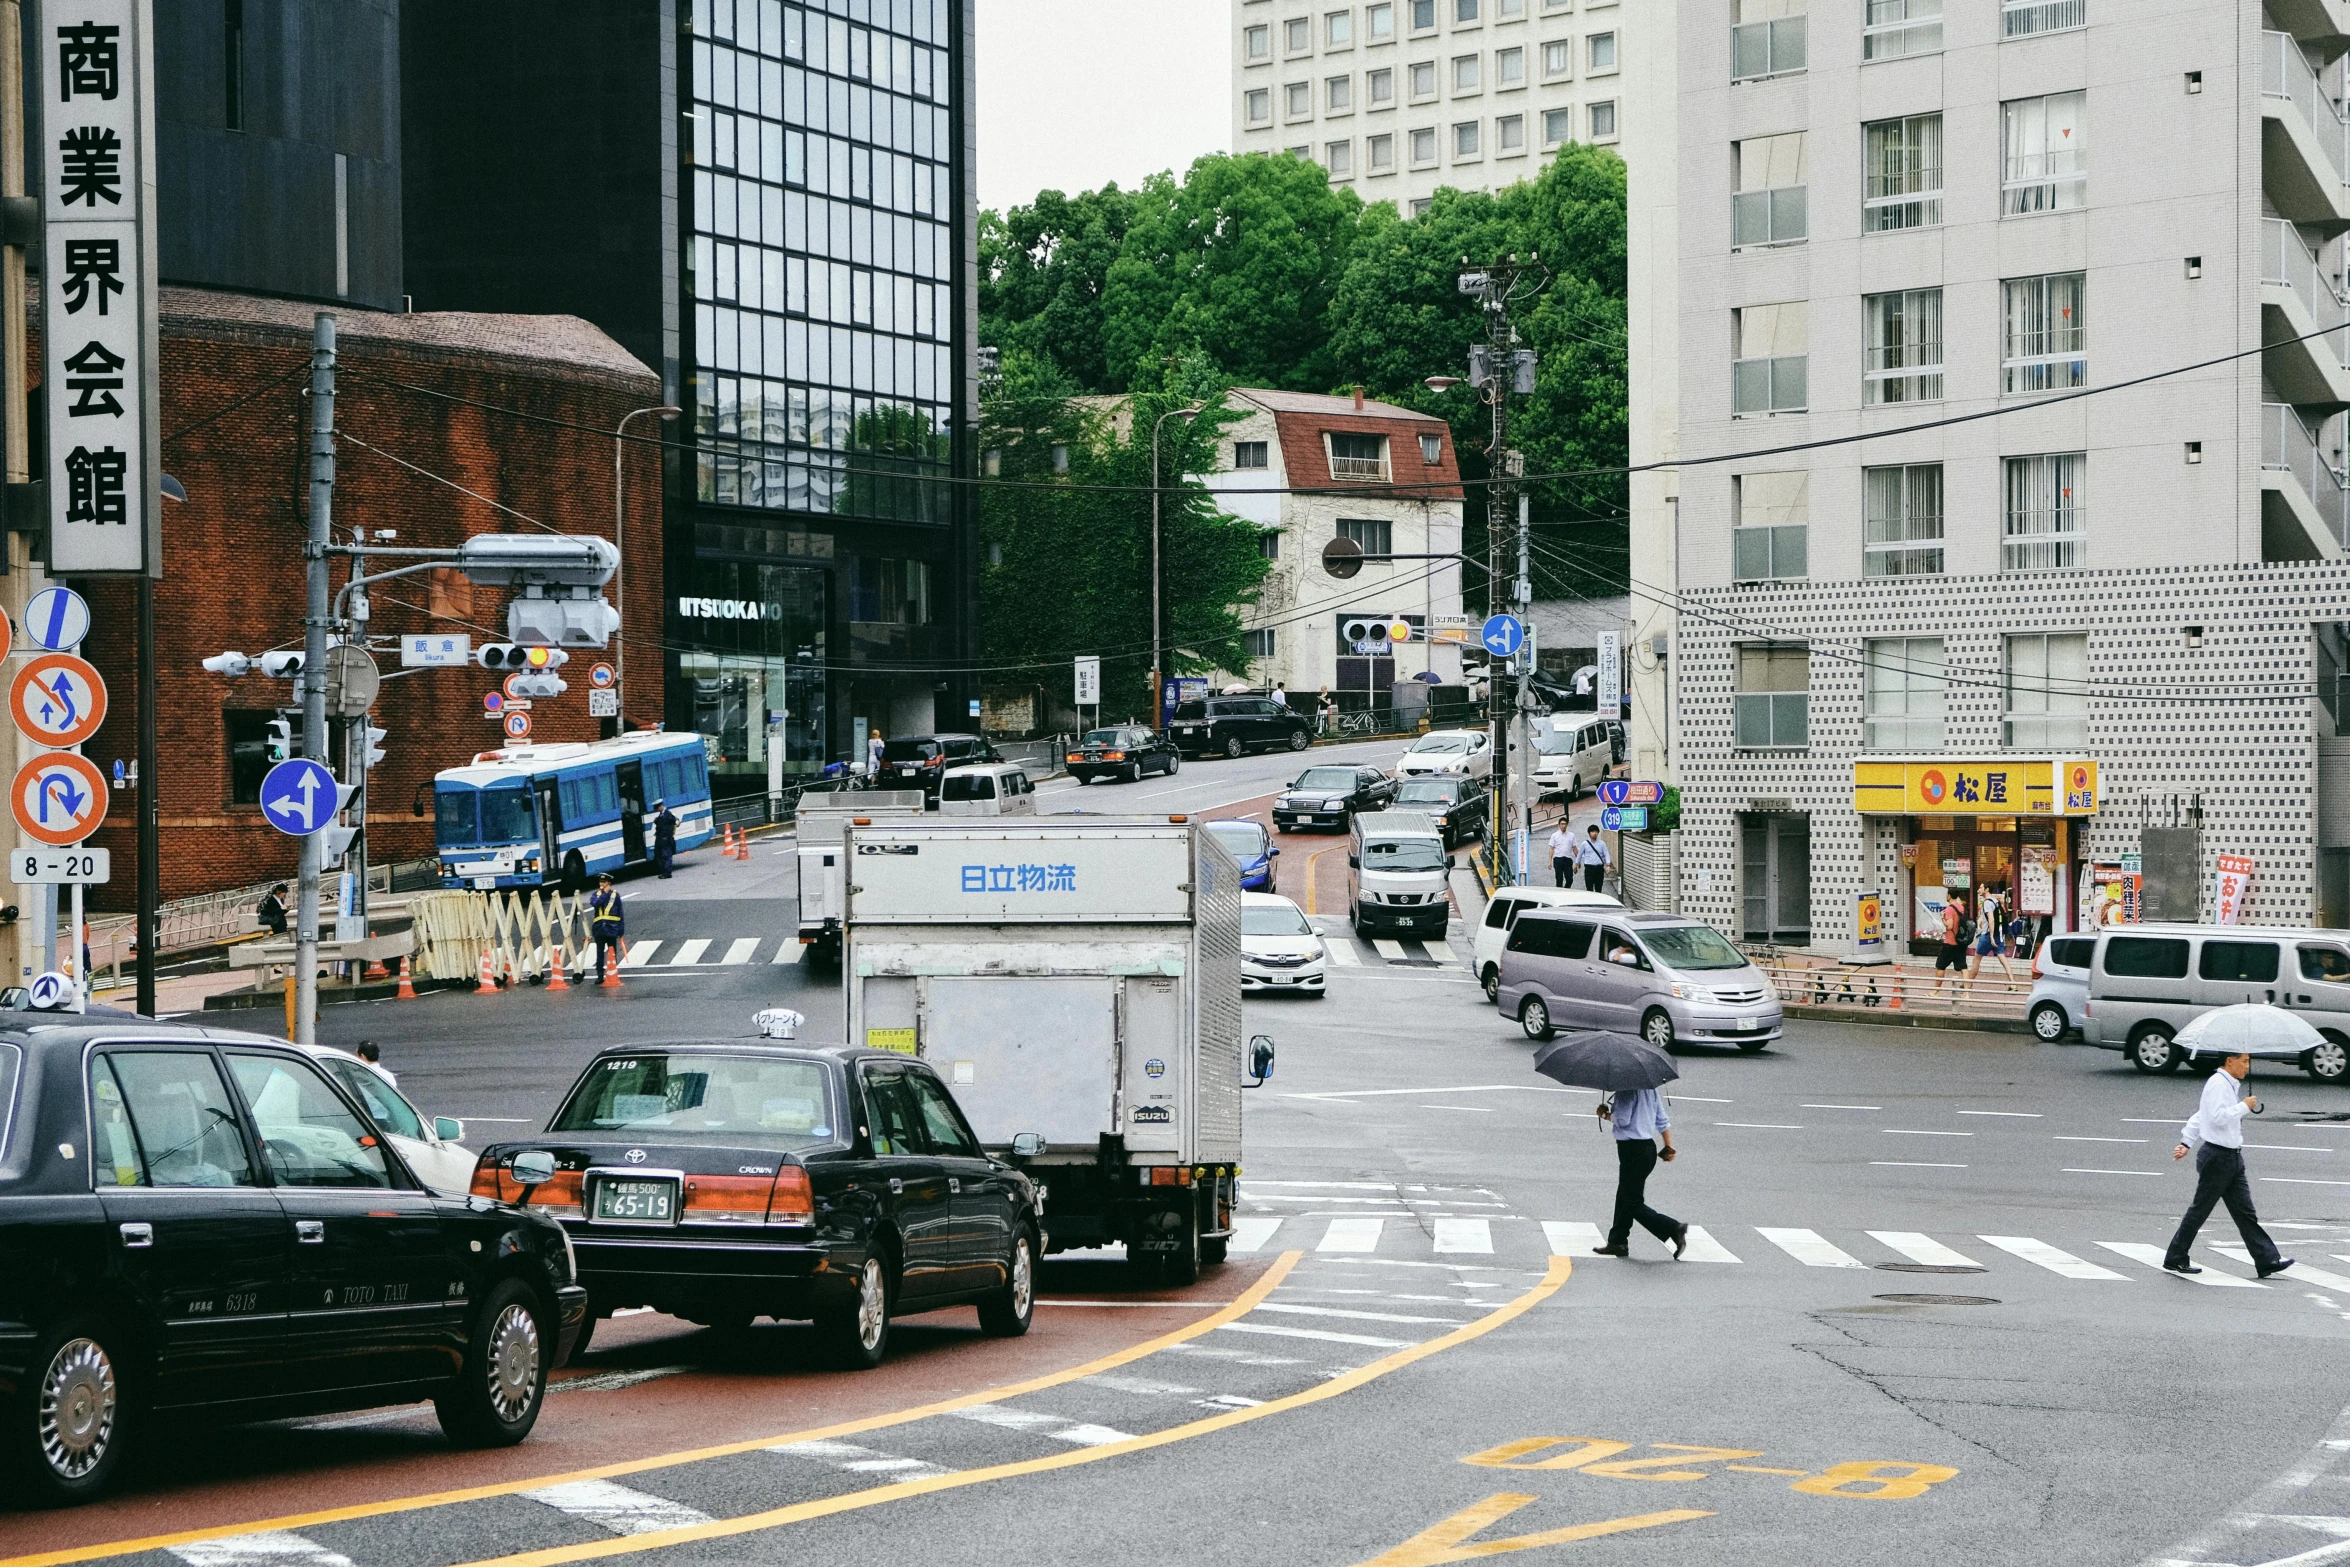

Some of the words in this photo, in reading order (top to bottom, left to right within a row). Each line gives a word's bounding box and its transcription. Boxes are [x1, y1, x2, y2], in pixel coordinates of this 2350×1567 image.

[57, 20, 127, 526] 商業界会館
[414, 639, 454, 653] 飯倉
[1079, 671, 1087, 699] 駐車場
[1613, 785, 1620, 799] 1
[1953, 772, 2008, 803] 松屋
[2067, 791, 2093, 808] 松屋
[1607, 812, 1620, 826] 319
[1903, 848, 1917, 858] 150
[2042, 854, 2056, 863] 150
[961, 863, 1076, 893] 日立物流
[2221, 875, 2238, 925] お弁
[760, 1014, 791, 1024] グリーン
[607, 1060, 637, 1070] 1219
[1134, 1112, 1169, 1121] ISUZU
[738, 1165, 773, 1174] CROWN
[639, 1183, 657, 1194] 500
[604, 1200, 611, 1210] う
[614, 1195, 669, 1216] 65-19
[344, 1286, 374, 1304] TOTO
[384, 1283, 409, 1302] TAXI
[225, 1292, 257, 1312] 6318
